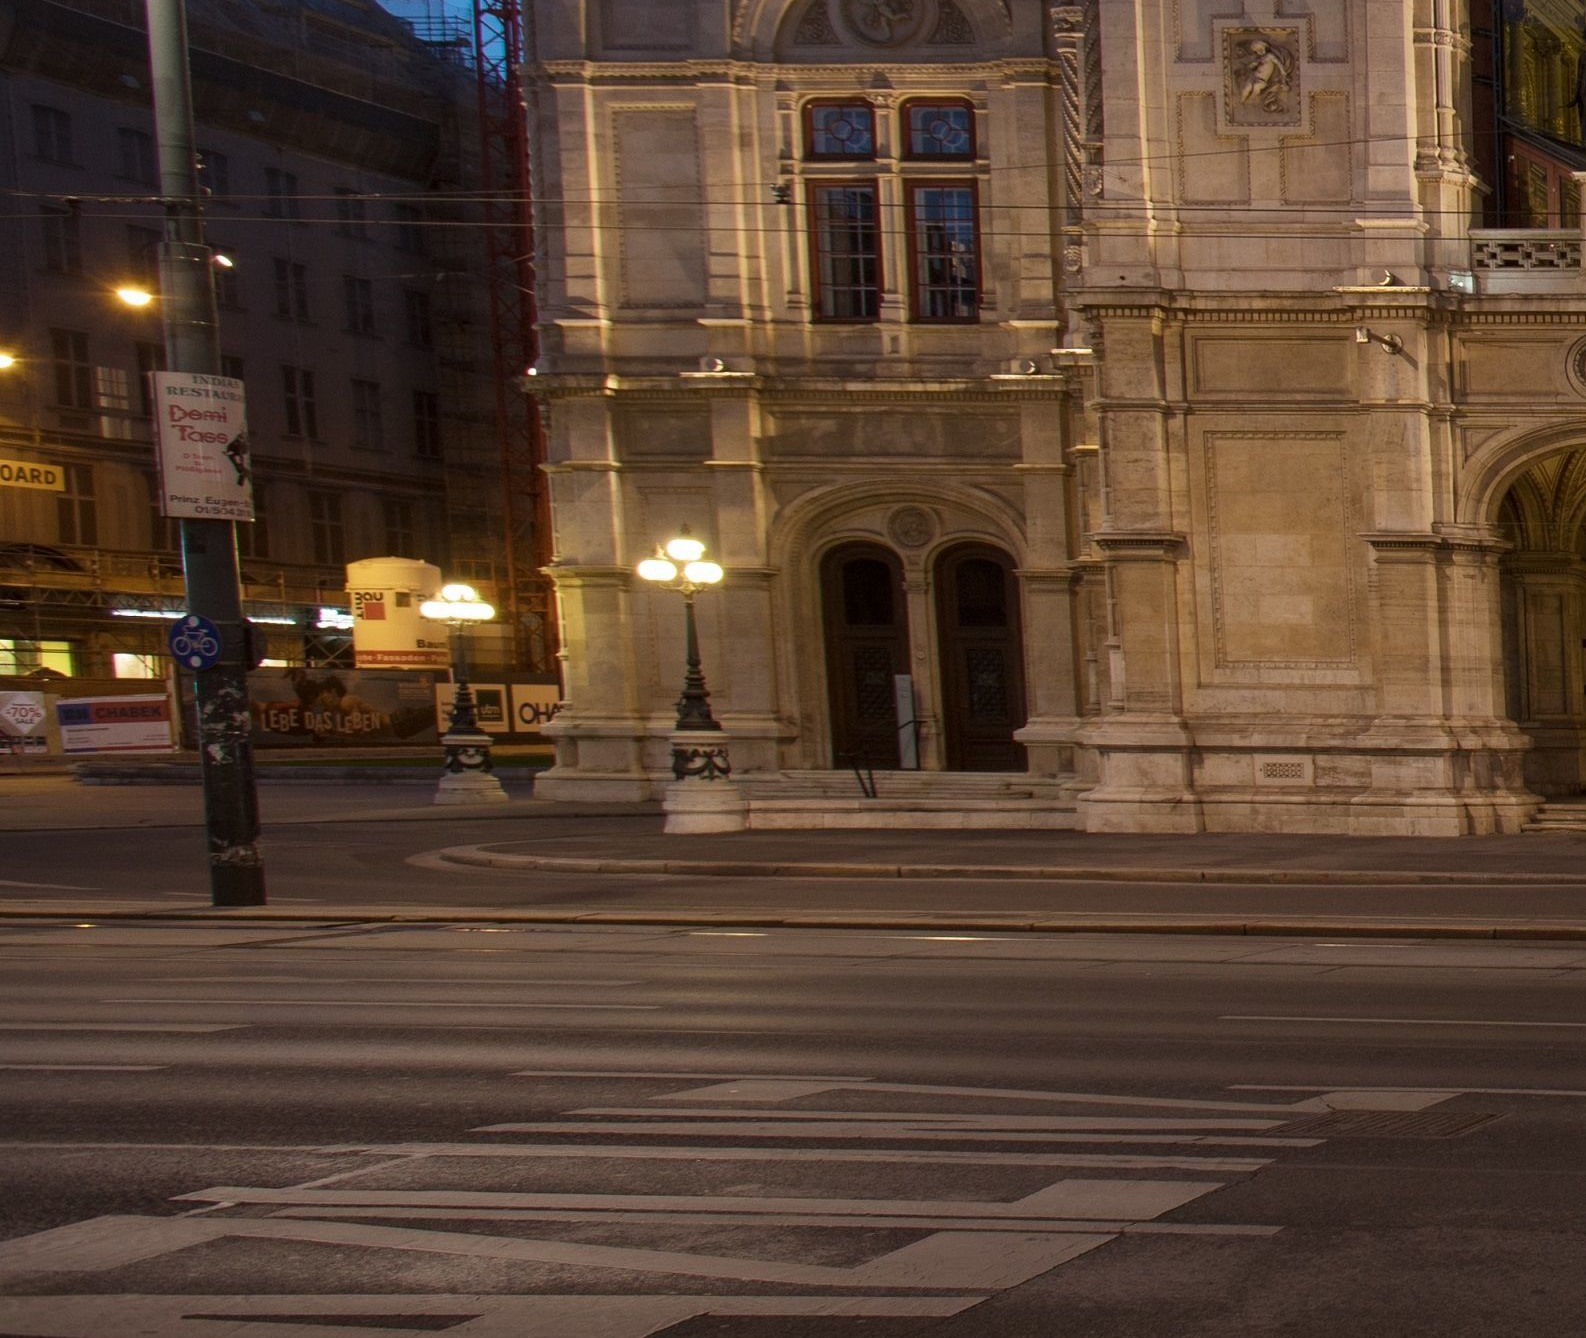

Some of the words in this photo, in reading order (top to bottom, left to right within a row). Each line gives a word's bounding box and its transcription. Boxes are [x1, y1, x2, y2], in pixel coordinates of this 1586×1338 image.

[169, 404, 227, 423] Demi
[172, 424, 229, 444] Tass
[170, 494, 200, 504] Prinz
[6, 707, 41, 718] -70%
[261, 709, 299, 732] LEBE
[304, 712, 333, 731] DAS
[335, 712, 380, 733] LEBEN
